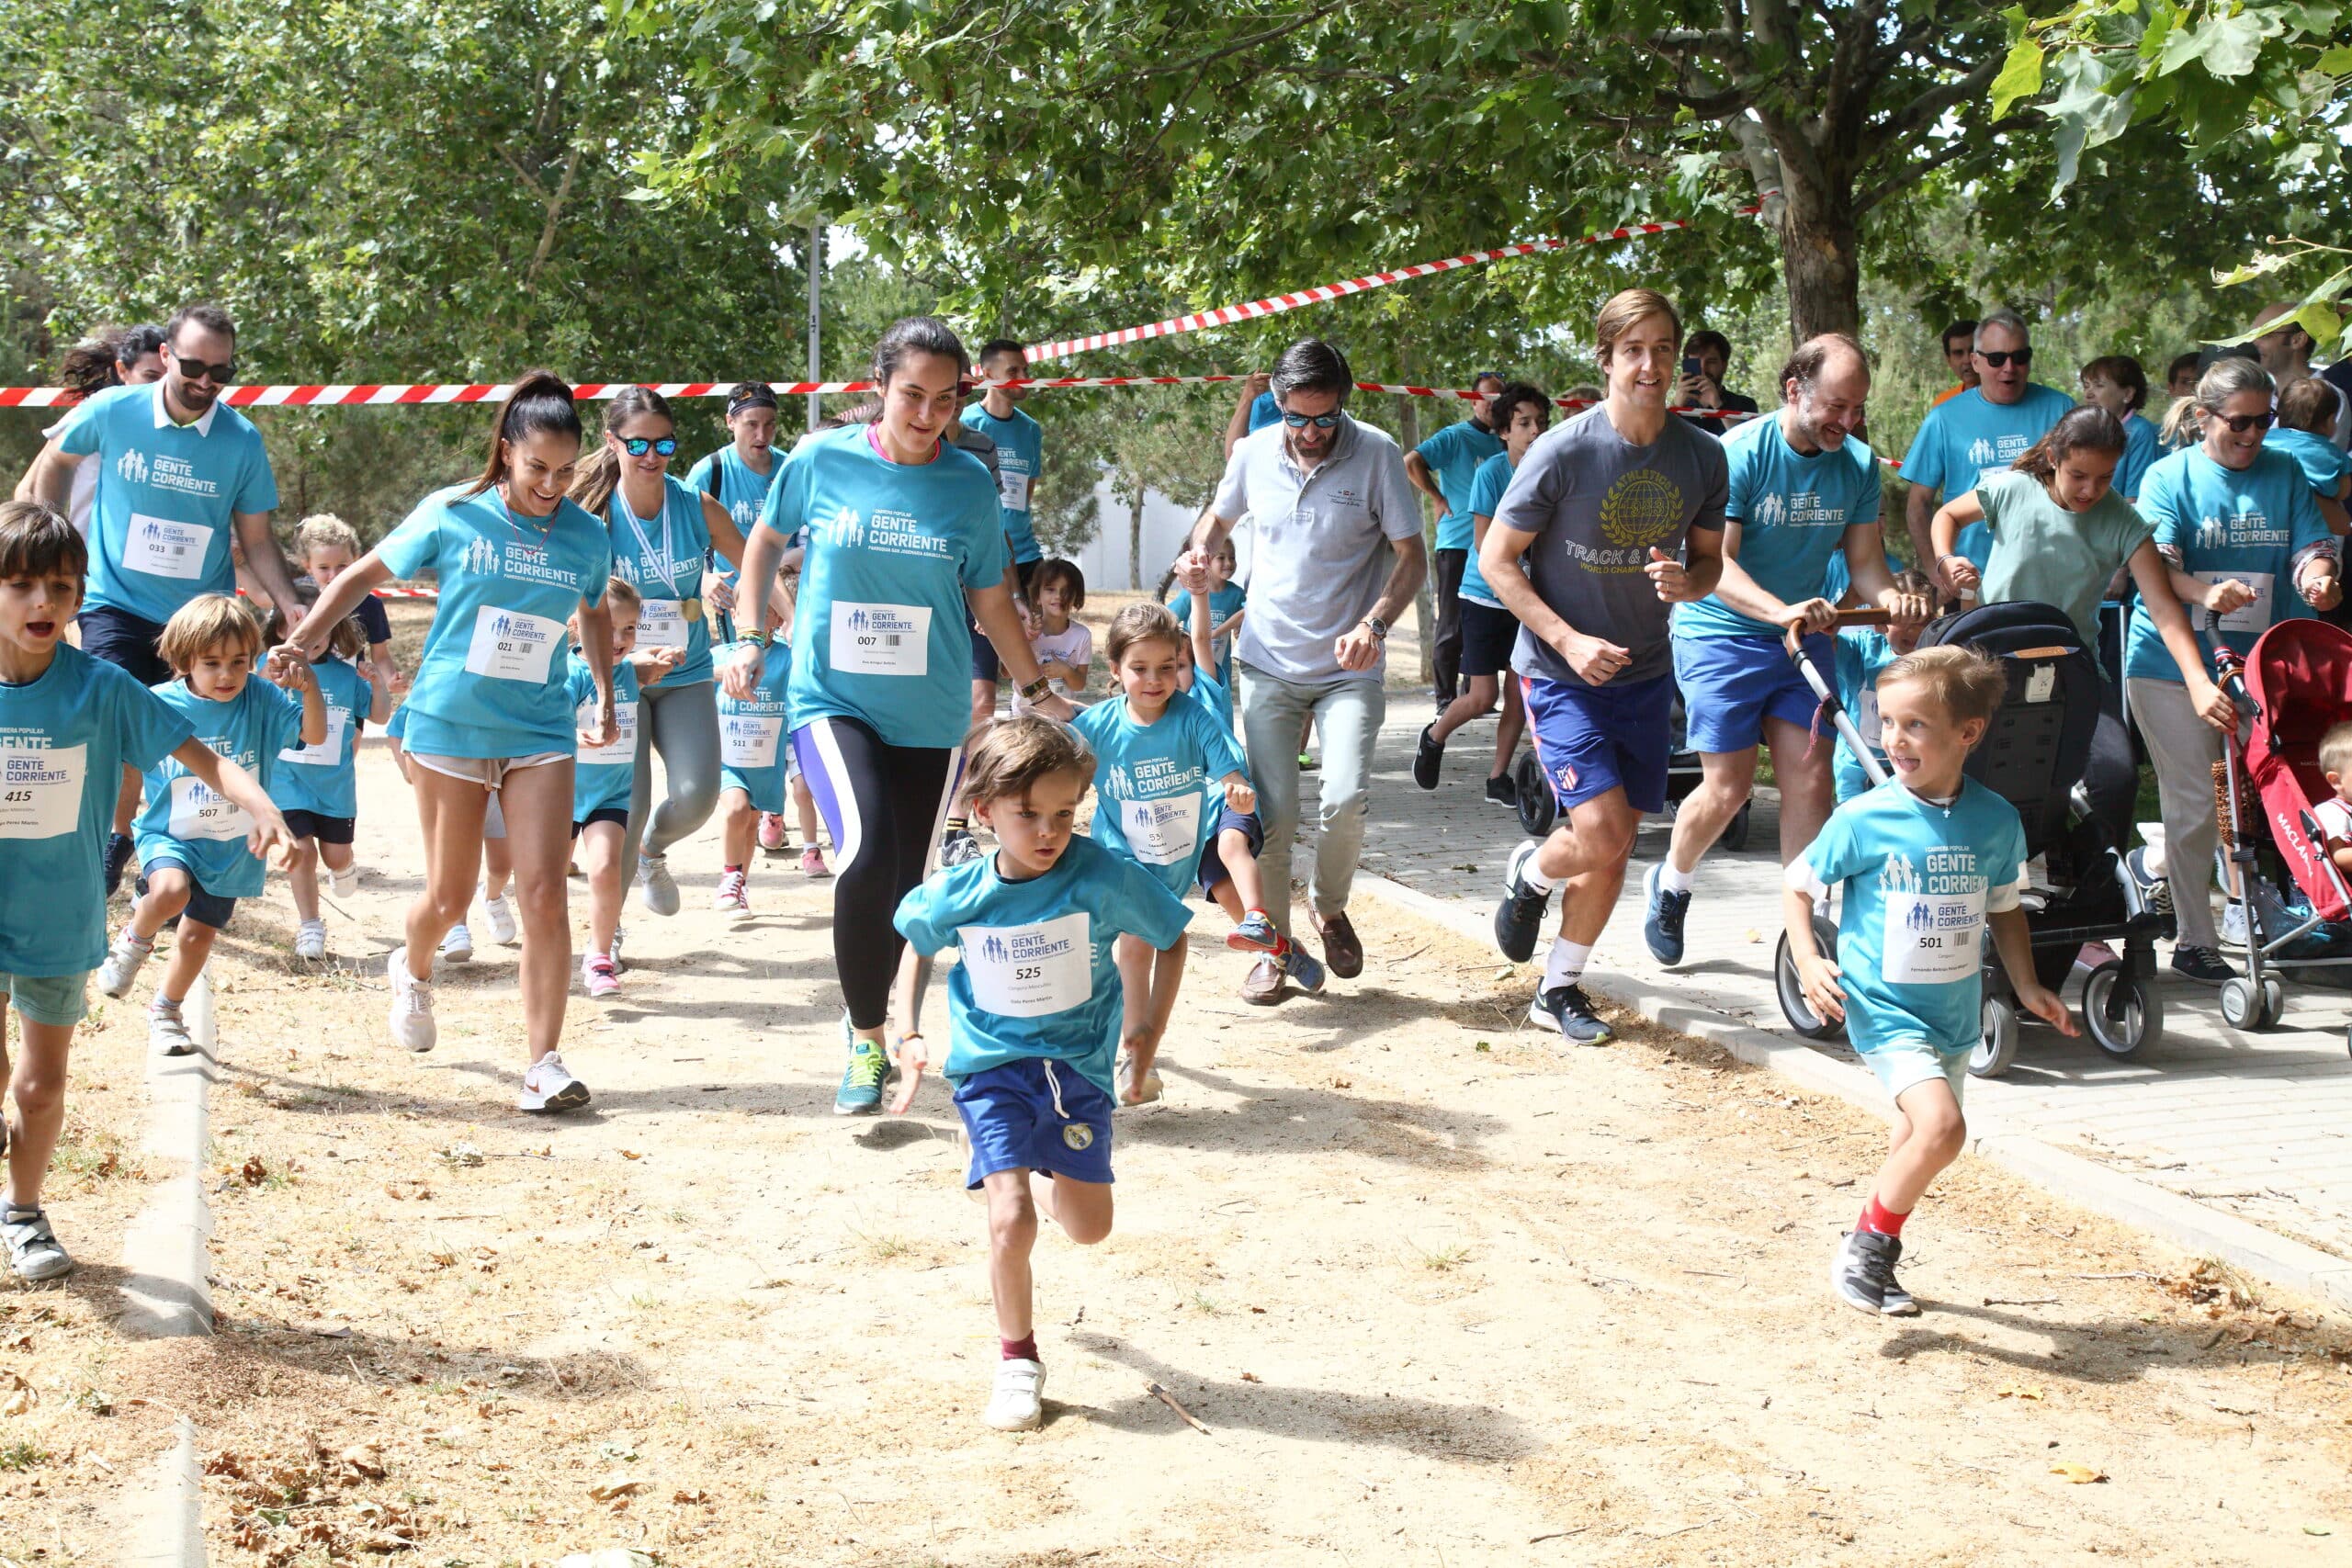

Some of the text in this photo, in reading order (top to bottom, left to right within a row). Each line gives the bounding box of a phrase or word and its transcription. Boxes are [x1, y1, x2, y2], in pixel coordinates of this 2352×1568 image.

[1997, 438, 2029, 448] GENTE
[154, 459, 193, 476] GENTE
[152, 472, 217, 492] CORRIENTE
[871, 514, 917, 533] GENTE
[164, 527, 184, 536] GENTE
[162, 534, 197, 544] CORRIENTE
[869, 530, 947, 551] CORRIENTE
[149, 544, 165, 553] 033
[1566, 540, 1624, 565] TRACK
[1628, 549, 1641, 564] &
[505, 547, 548, 566] GENTE
[505, 560, 577, 585] CORRIENTE
[1580, 561, 1610, 573] WORLD
[873, 613, 896, 621] GENTE
[514, 621, 535, 630] GENTE
[872, 621, 912, 629] CORRIENTE
[513, 628, 547, 640] CORRIENTE
[498, 641, 513, 652] 021
[858, 636, 876, 646] 007
[7, 760, 44, 771] GENTE
[1135, 761, 1176, 779] GENTE
[6, 770, 66, 781] CORRIENTE
[1137, 766, 1202, 794] CORRIENTE
[5, 791, 32, 802] 415
[198, 808, 218, 818] 507
[1154, 805, 1172, 816] GENTE
[1155, 810, 1187, 823] CORRIENTE
[1927, 854, 1976, 873] GENTE
[1939, 906, 1967, 916] GENTE
[1938, 913, 1980, 927] CORRIENTE
[1012, 934, 1046, 948] GENTE
[1920, 937, 1942, 948] 501
[1012, 939, 1069, 959] CORRIENTE
[1016, 966, 1041, 980] 525
